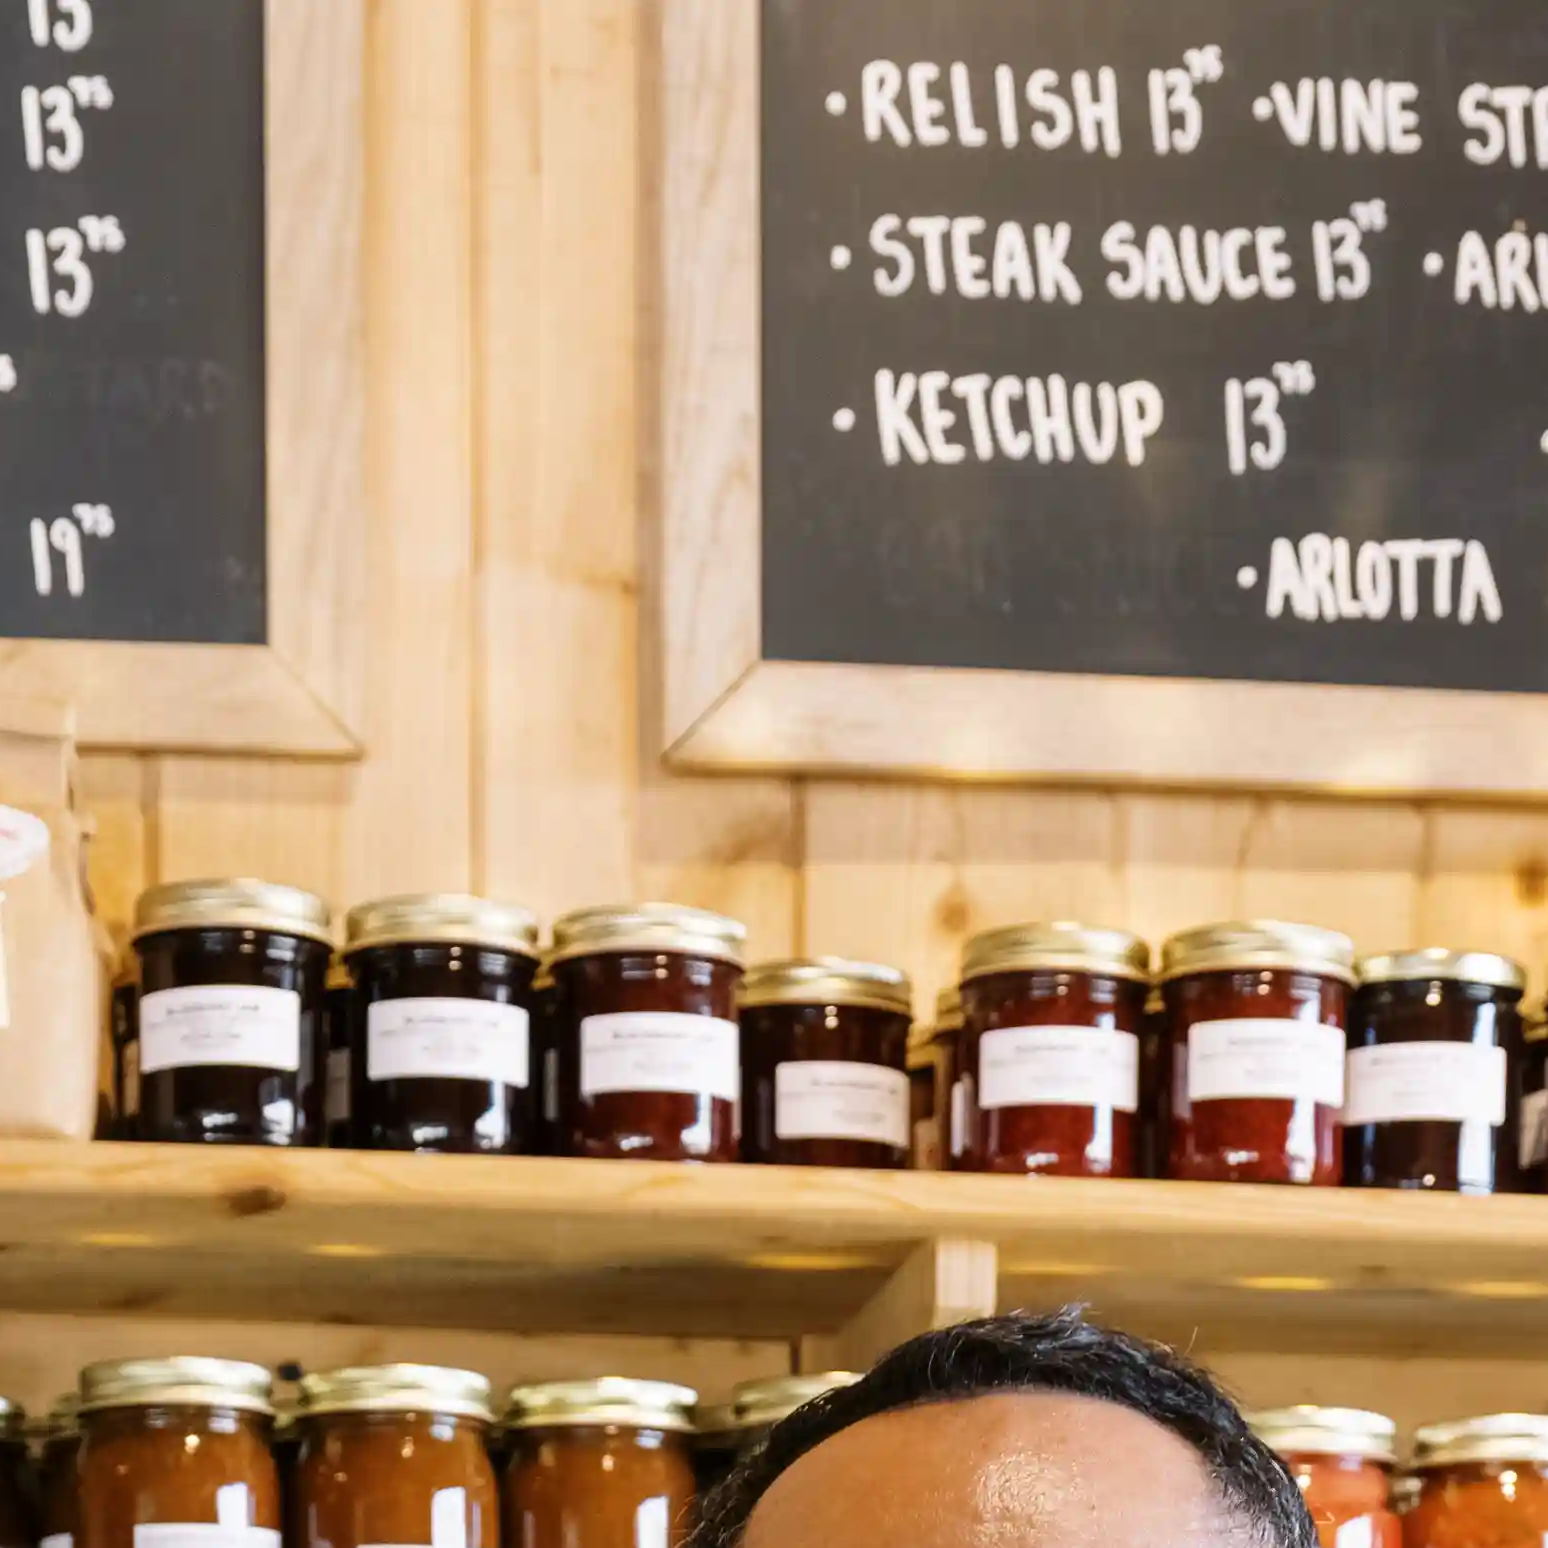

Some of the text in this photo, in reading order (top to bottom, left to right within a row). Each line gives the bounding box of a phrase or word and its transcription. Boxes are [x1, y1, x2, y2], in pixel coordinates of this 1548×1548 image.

[861, 58, 1121, 158] RELISH
[1268, 75, 1424, 155] VINE
[868, 213, 1083, 306] STEAK
[1100, 220, 1296, 305] SAUCE
[874, 368, 1164, 467] KETCHUP
[1265, 533, 1505, 624] ARLOTTA
